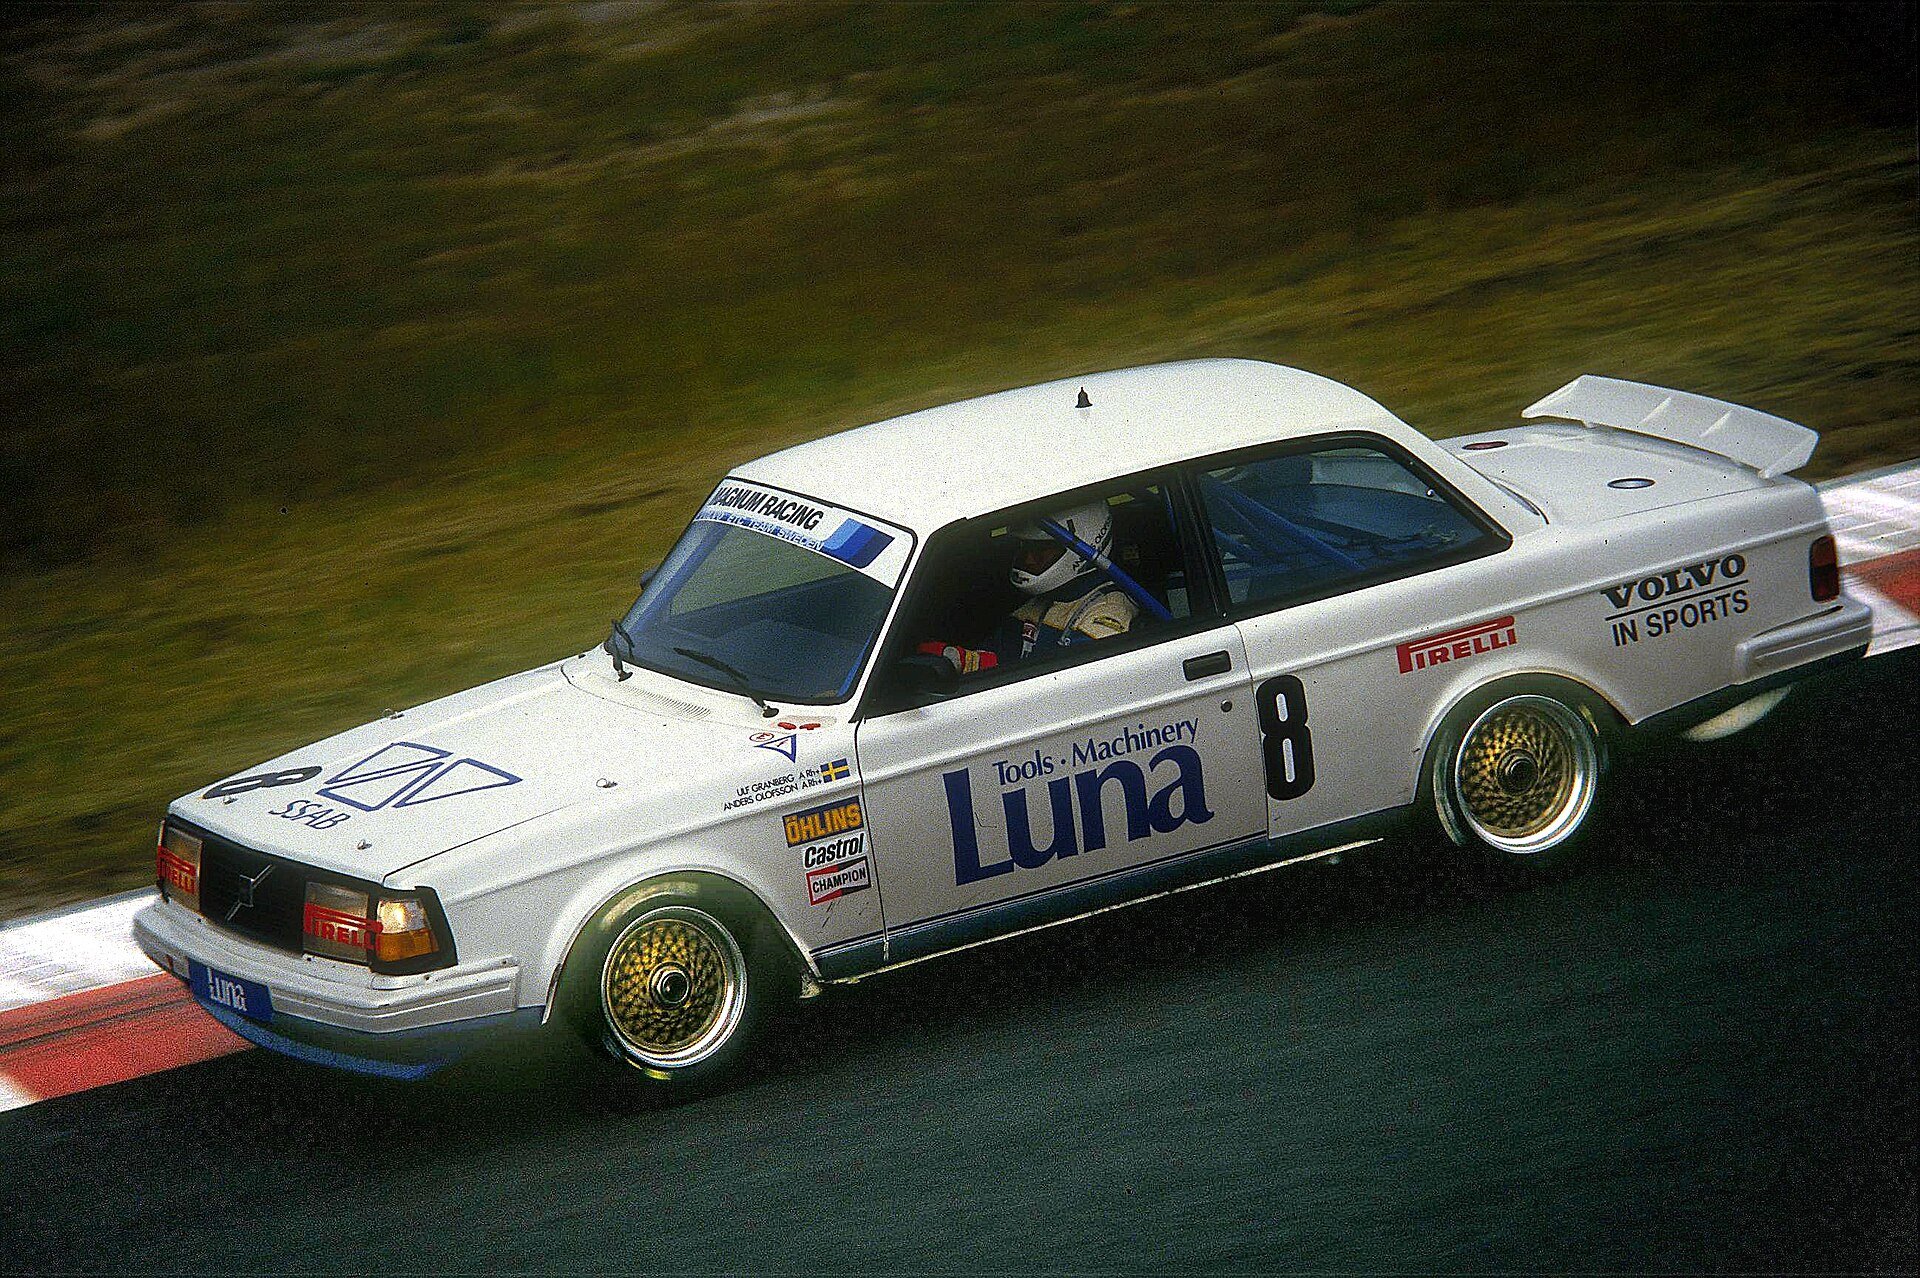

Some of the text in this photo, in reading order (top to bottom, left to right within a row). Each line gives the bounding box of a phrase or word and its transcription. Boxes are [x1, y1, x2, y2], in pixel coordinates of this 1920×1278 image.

[708, 487, 823, 530] MAGNUM RACING
[748, 518, 777, 535] TEAM
[776, 526, 824, 551] SWEDEN
[1601, 553, 1746, 609] VOLVO
[1612, 589, 1749, 647] IN SPORTS
[1396, 615, 1518, 674] PIRELLI
[993, 717, 1199, 785] Tools Machinery
[1255, 674, 1316, 801] 8
[202, 765, 322, 799] 8
[723, 795, 755, 811] ANDERS
[755, 783, 799, 802] OLOFSSON
[802, 781, 809, 790] A
[736, 785, 750, 797] ULF
[751, 774, 795, 793] GRANBERG
[798, 772, 806, 780] A
[268, 799, 351, 830] SSAB
[786, 804, 862, 843] ÖHLINS
[942, 744, 1215, 886] Luna
[804, 832, 865, 868] Castrol
[812, 867, 866, 893] CHAMPION
[303, 902, 384, 953] PIRELLI
[207, 966, 248, 1012] Luna
